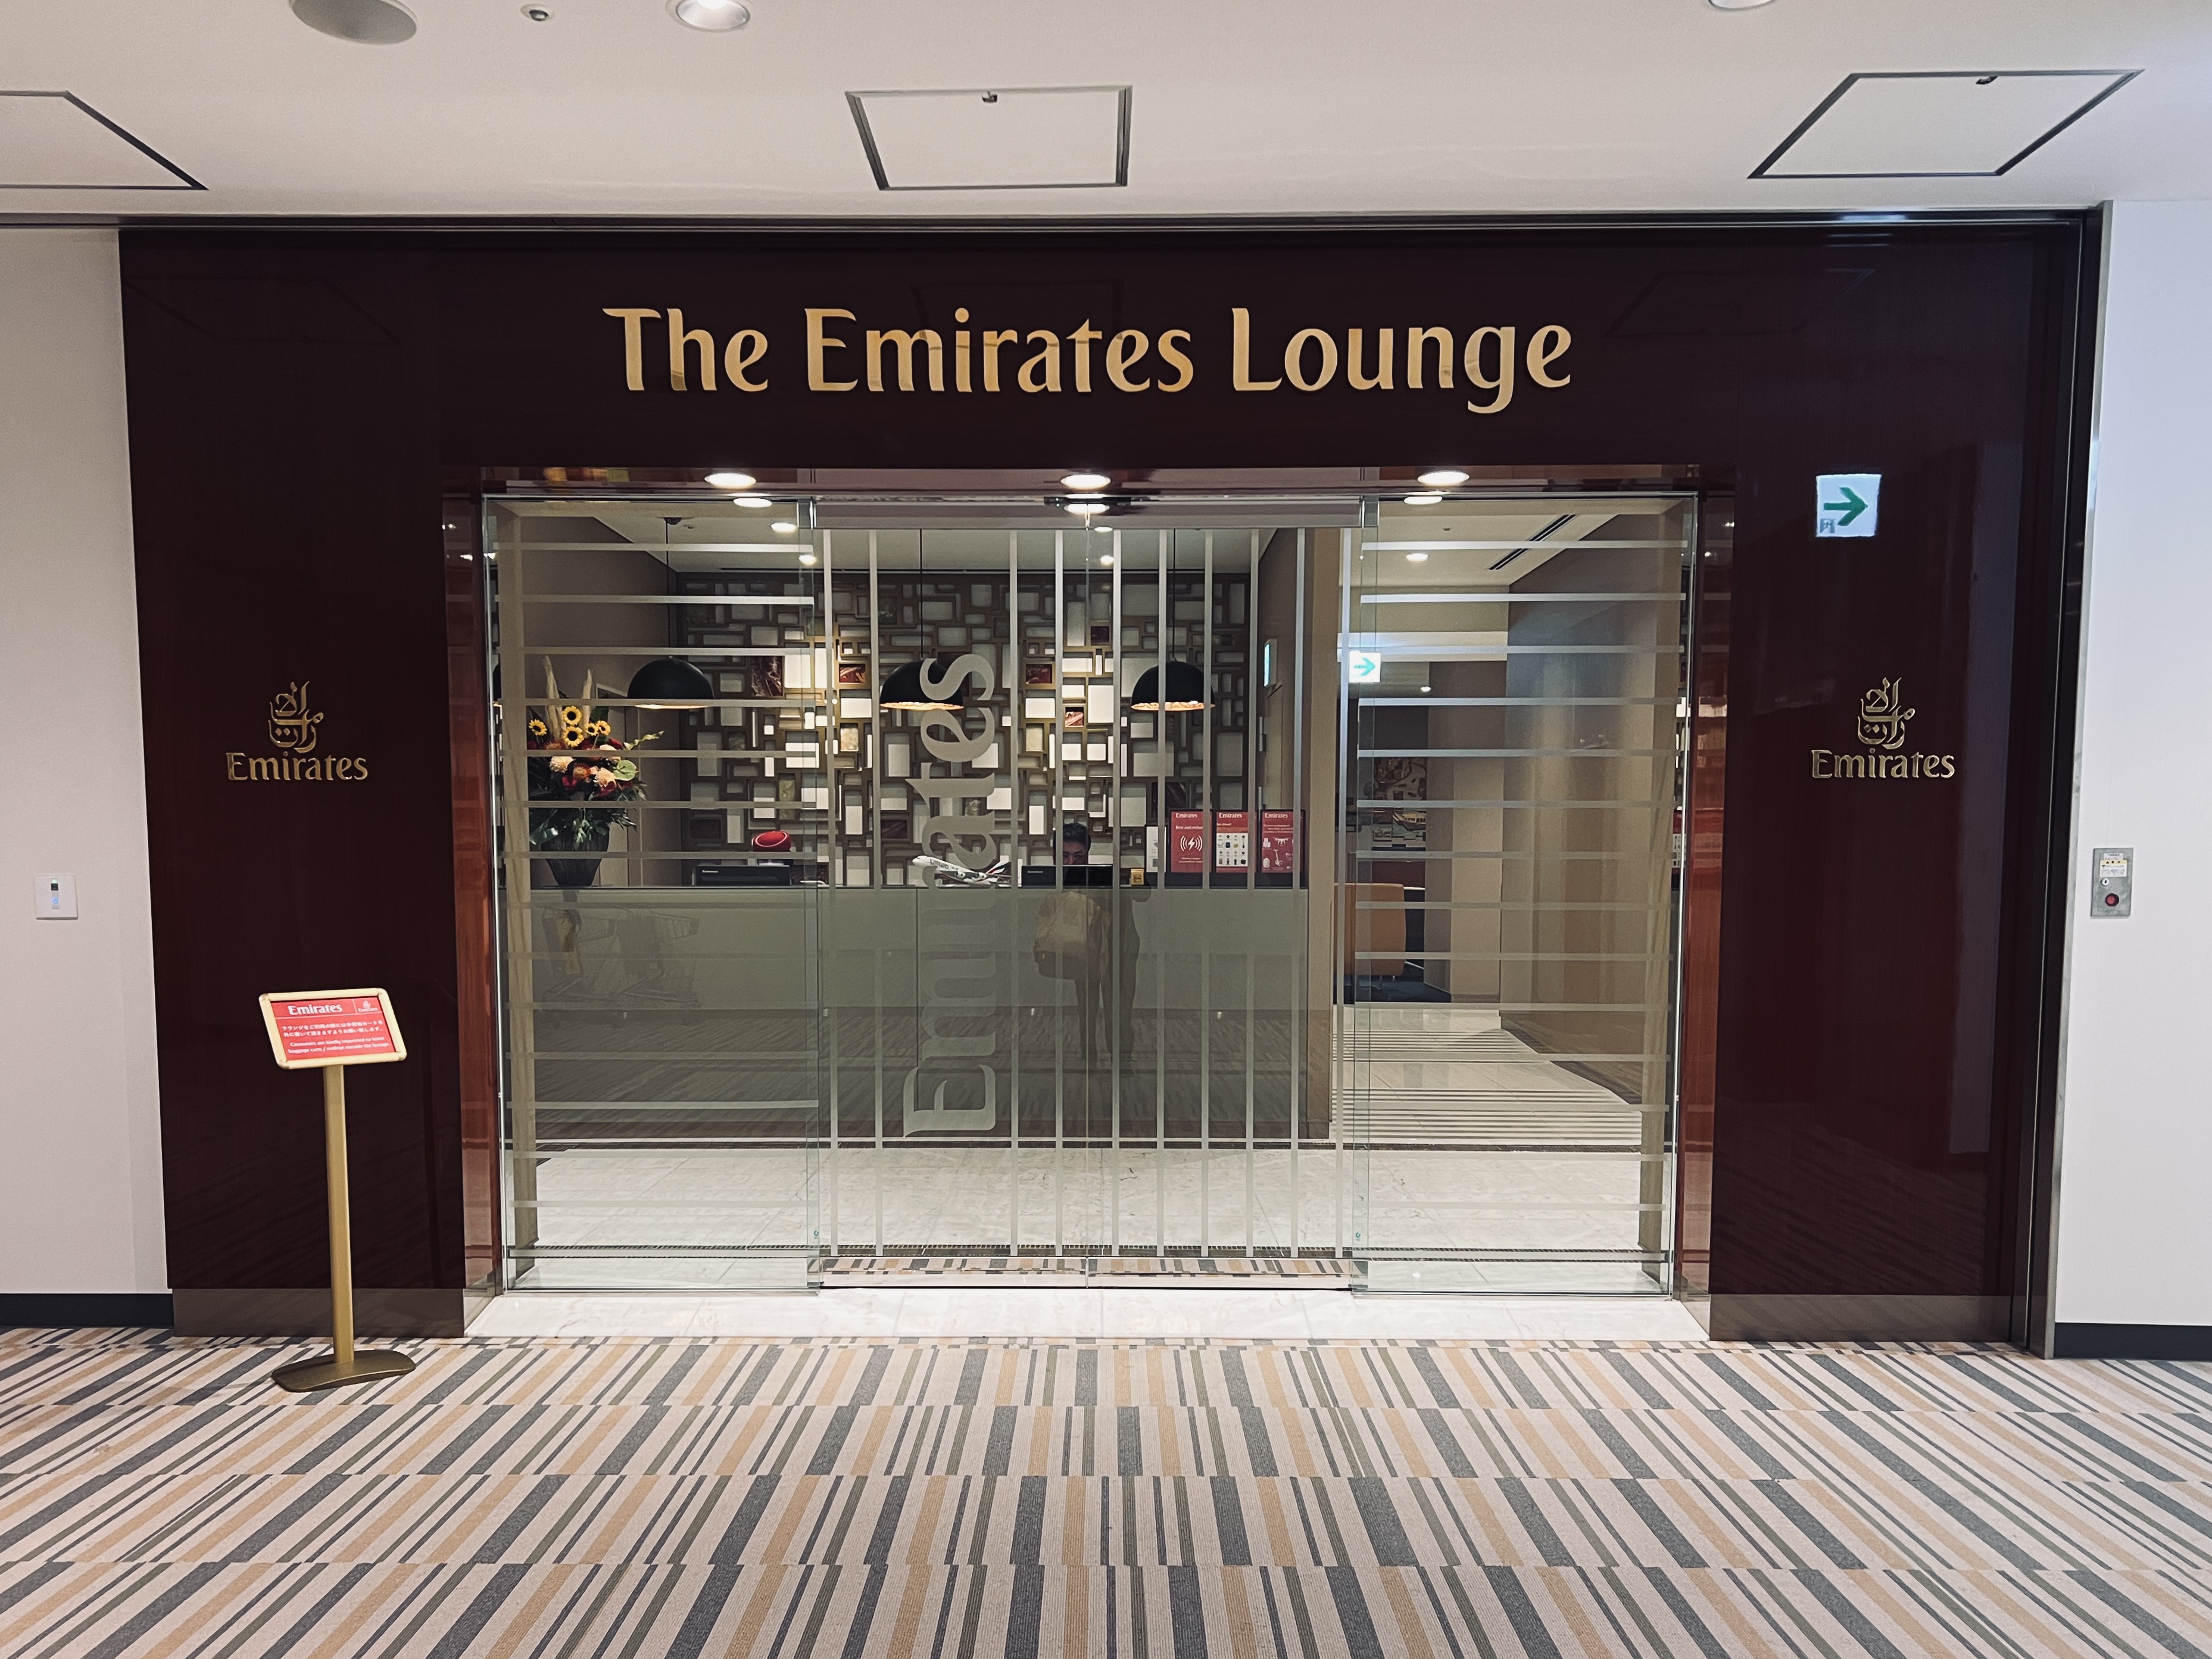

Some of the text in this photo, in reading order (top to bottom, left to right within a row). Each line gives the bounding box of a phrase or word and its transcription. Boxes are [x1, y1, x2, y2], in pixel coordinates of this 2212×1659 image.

[602, 307, 1571, 414] The Emirates Lounge
[225, 751, 368, 780] Emirates
[1811, 748, 1955, 778] Emirates
[903, 654, 996, 1137] Emirates
[288, 1003, 343, 1015] Emirates
